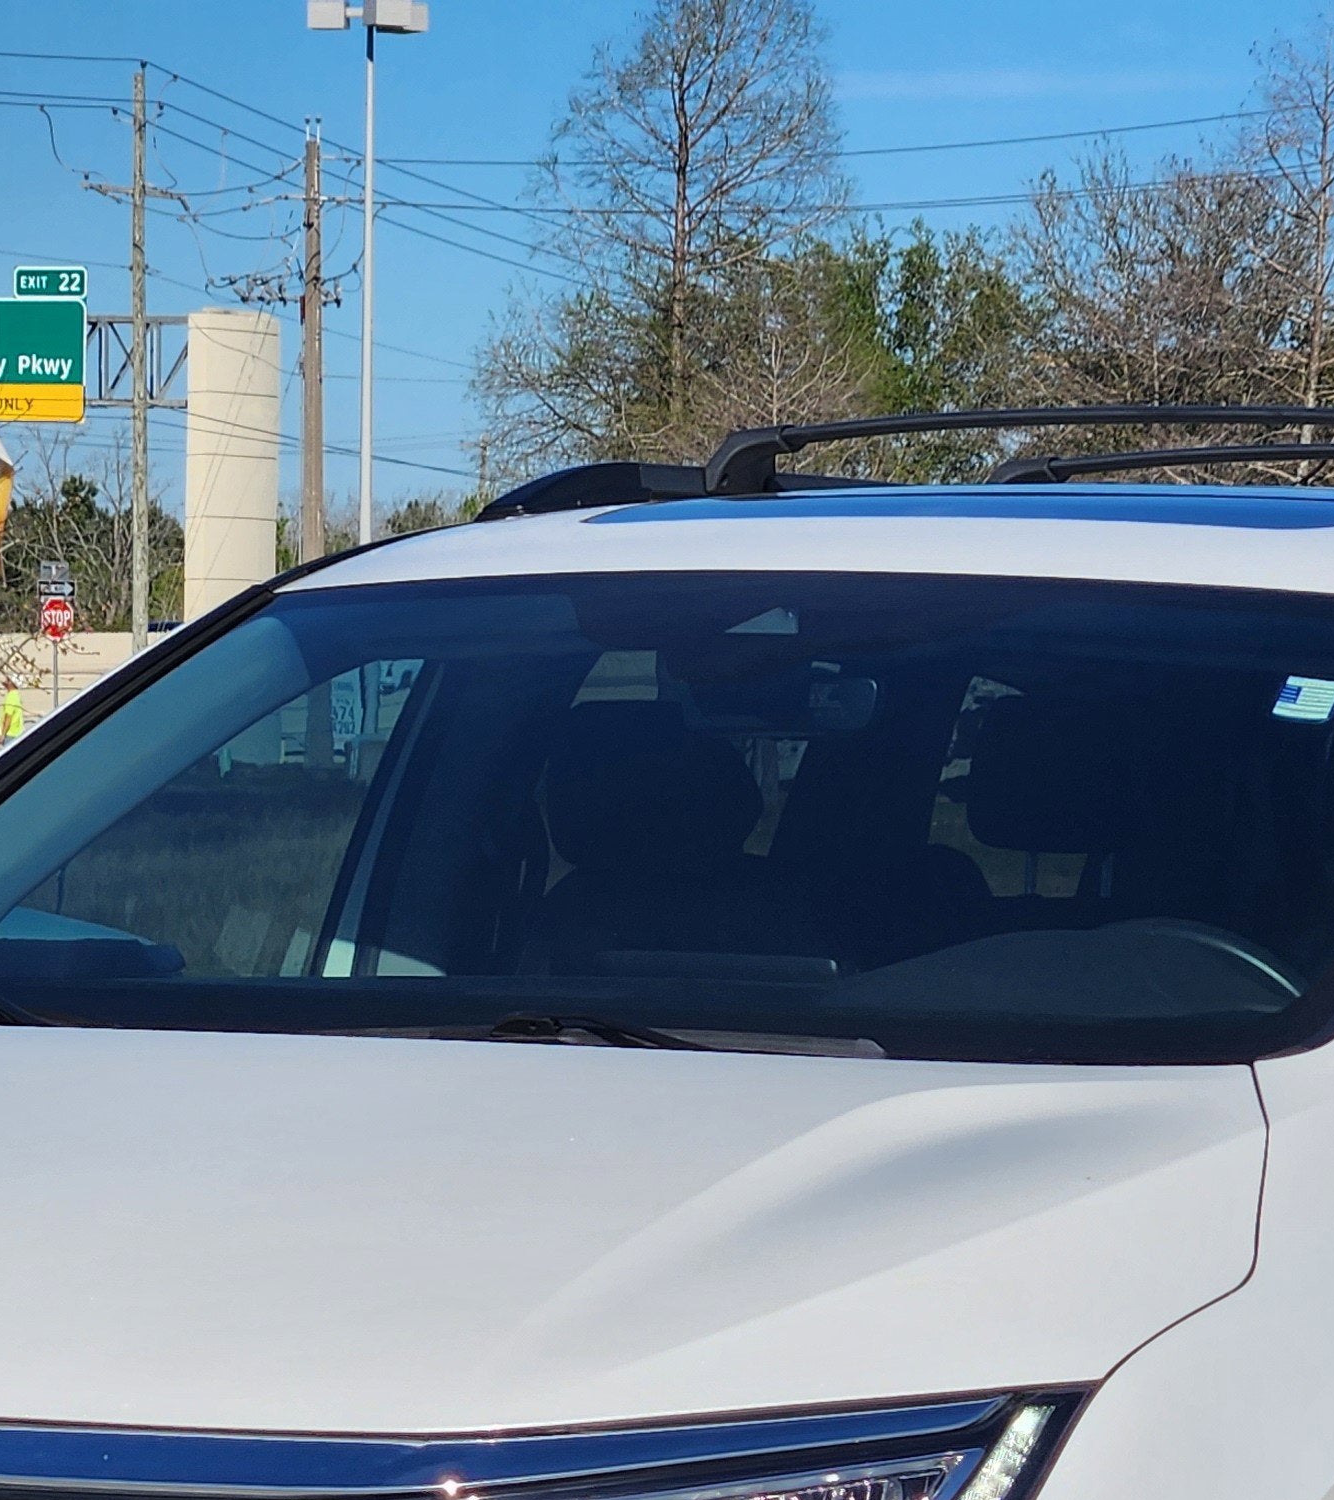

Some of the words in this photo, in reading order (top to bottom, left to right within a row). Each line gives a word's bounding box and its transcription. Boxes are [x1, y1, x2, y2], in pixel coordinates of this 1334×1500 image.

[20, 275, 47, 289] EXIT
[58, 273, 81, 292] 22
[18, 353, 73, 381] Pkwy
[43, 610, 71, 628] STOP
